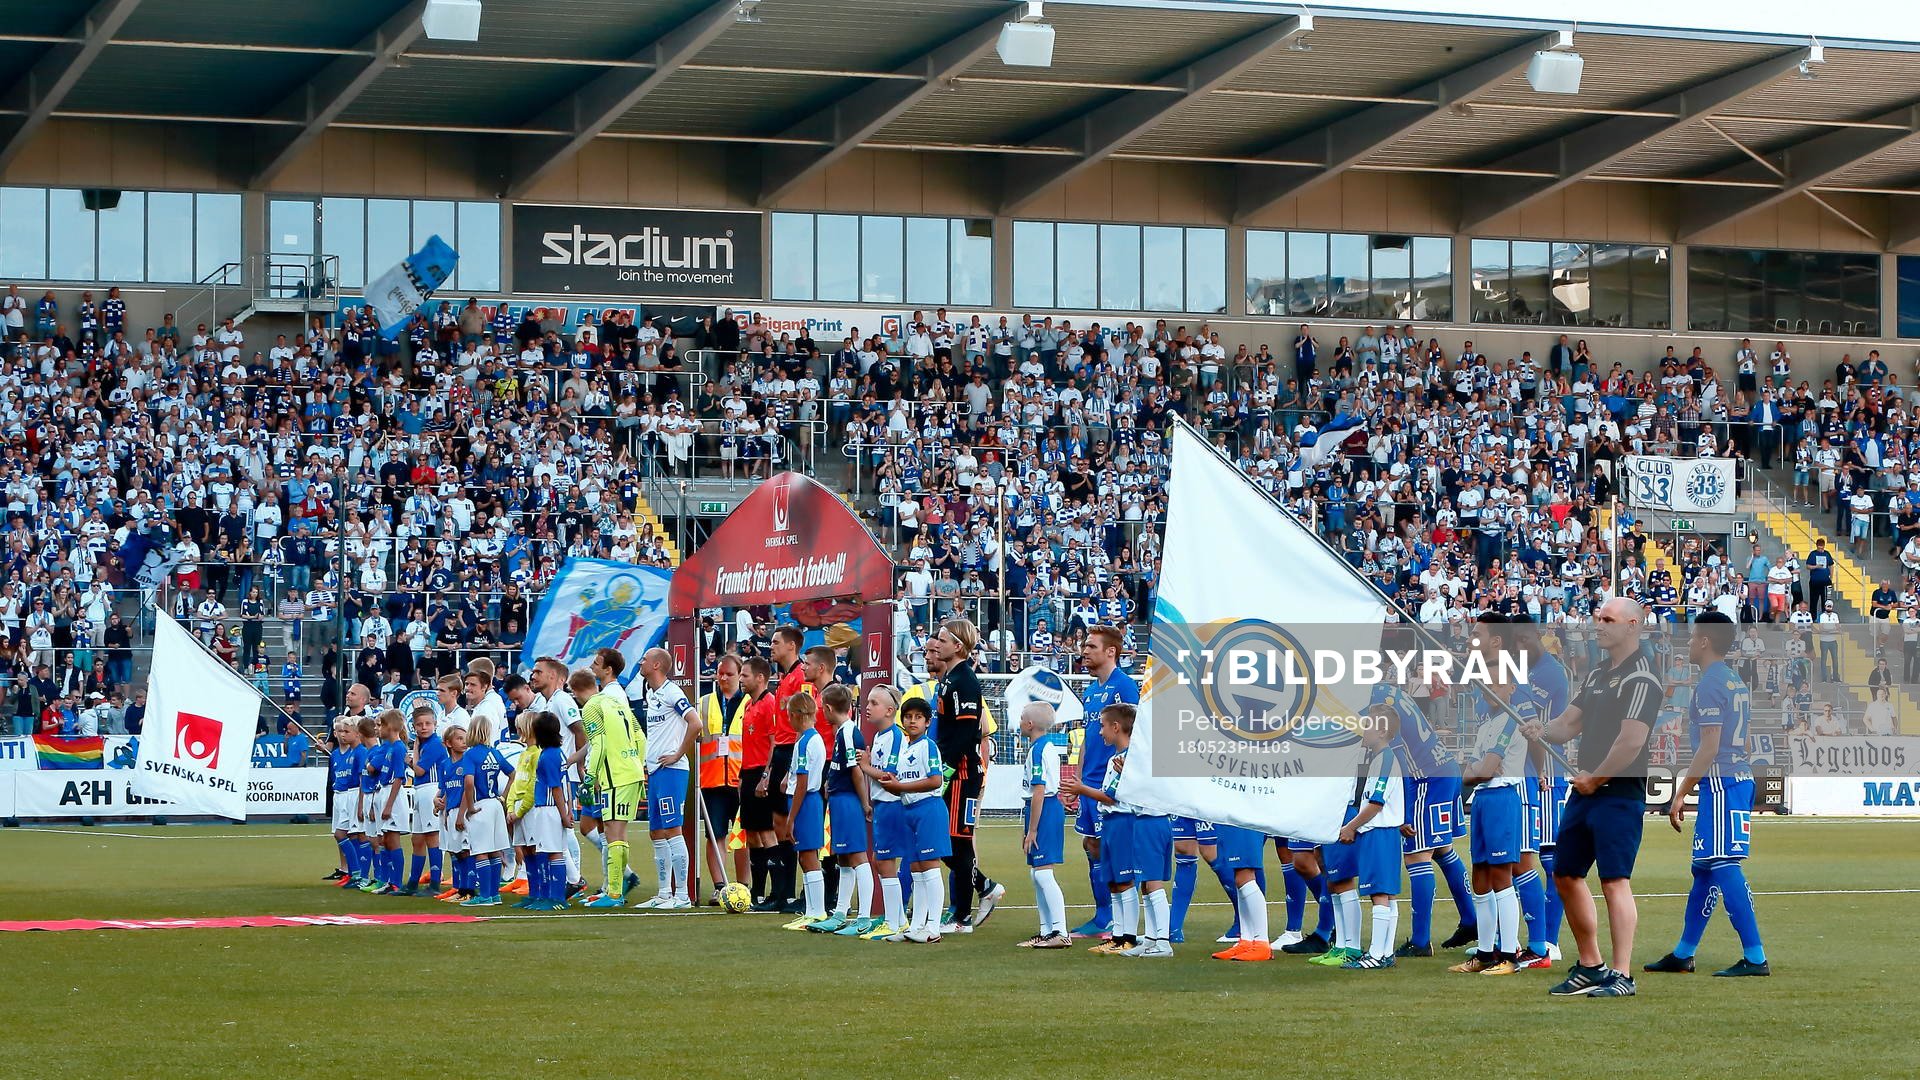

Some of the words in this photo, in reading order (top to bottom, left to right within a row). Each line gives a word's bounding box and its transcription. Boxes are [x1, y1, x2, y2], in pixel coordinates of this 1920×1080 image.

[542, 225, 733, 269] stadium
[617, 269, 640, 282] Join
[643, 270, 664, 283] the
[667, 272, 733, 284] movement
[1638, 461, 1672, 475] CLUB
[1640, 476, 1669, 503] 33
[1694, 475, 1717, 495] 33
[765, 536, 785, 548] SVENSKA
[786, 535, 798, 545] SPEL
[715, 563, 752, 595] Framåt
[752, 562, 769, 592] för
[768, 558, 805, 591] svensk
[805, 552, 846, 587] fotboll!
[1794, 738, 1905, 773] Legendos
[145, 760, 204, 784] SVENSKA
[209, 777, 237, 793] SPEL
[248, 782, 273, 791] BYGG
[1211, 775, 1246, 792] SEDAN
[1252, 786, 1275, 795] 1924
[246, 792, 319, 802] KOORDINATOR
